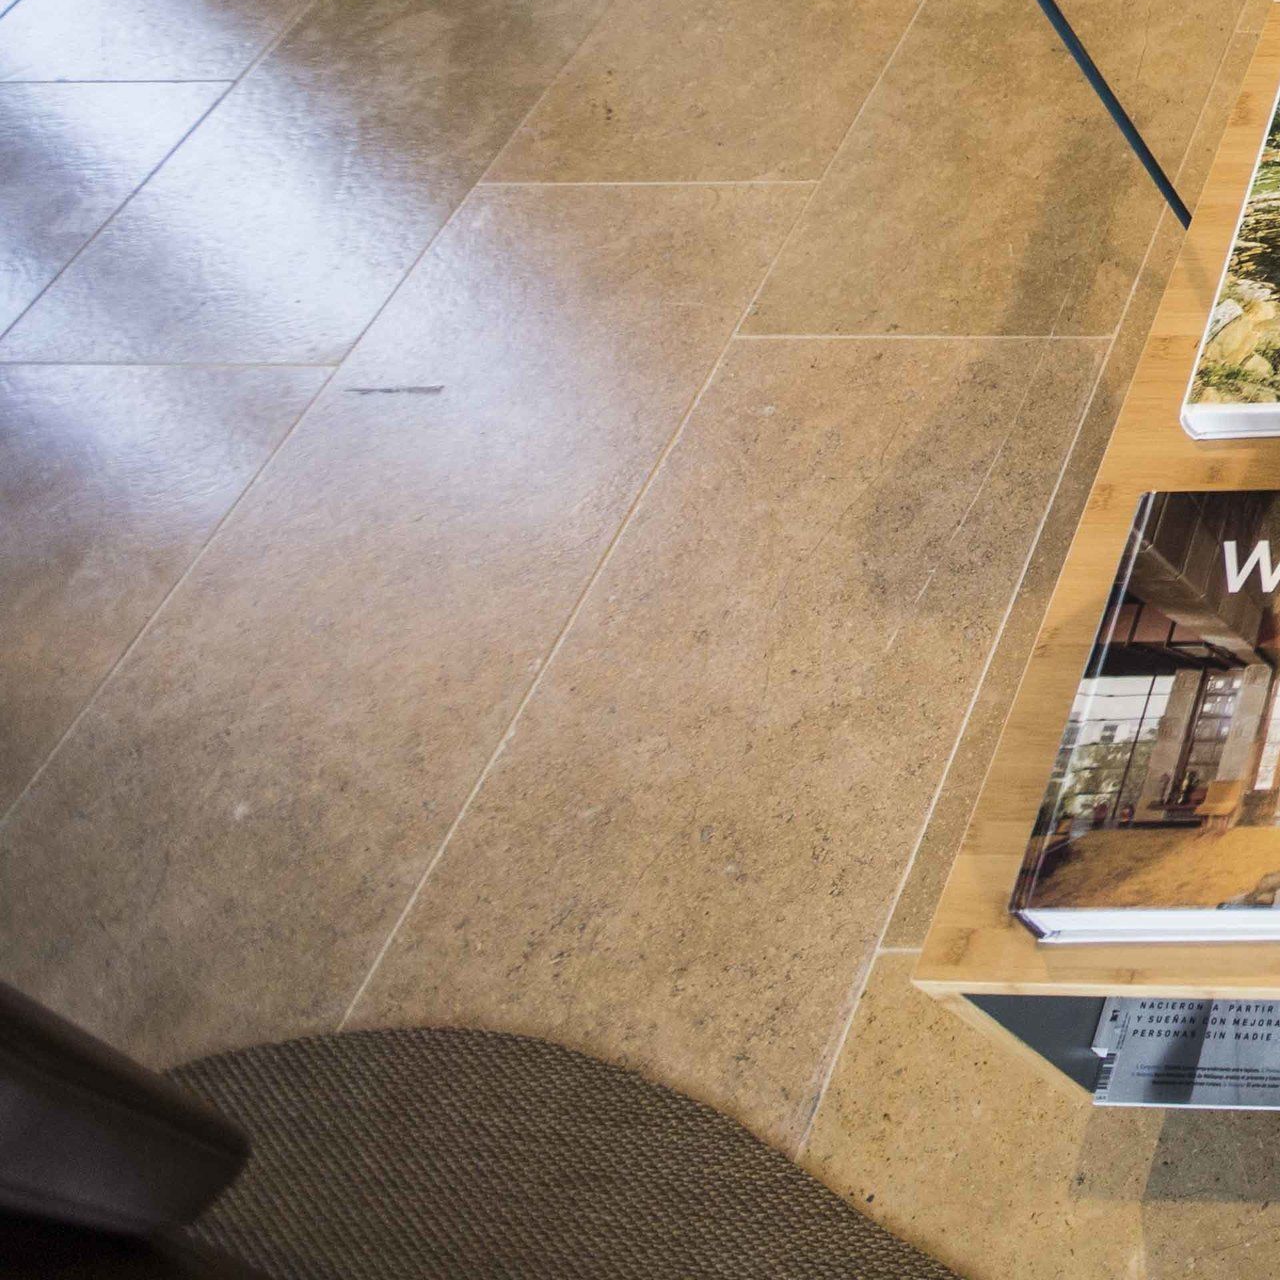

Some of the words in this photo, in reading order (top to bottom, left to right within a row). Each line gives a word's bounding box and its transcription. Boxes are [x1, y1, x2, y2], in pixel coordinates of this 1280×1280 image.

[1140, 1001, 1203, 1010] NACIERON
[1229, 1004, 1274, 1013] PARTIR
[1136, 1015, 1142, 1023] Y
[1148, 1014, 1195, 1025] SUEÑAN
[1202, 1017, 1226, 1026] CON
[1132, 1029, 1197, 1038] PERSONAS
[1205, 1031, 1226, 1039] SIN
[1234, 1033, 1272, 1041] NADIE
